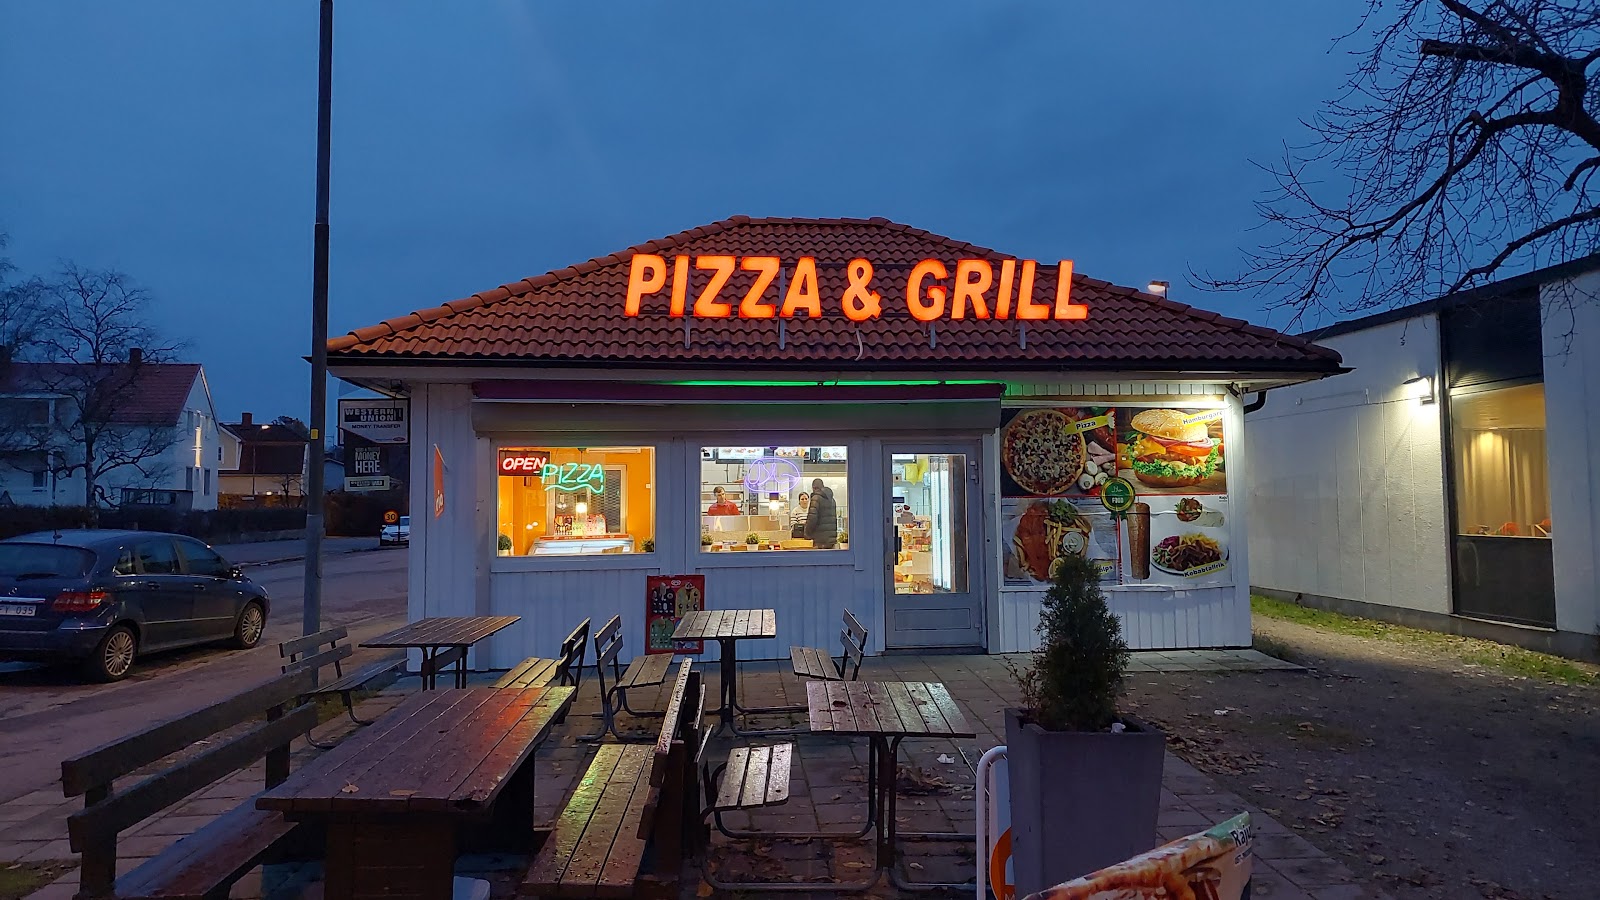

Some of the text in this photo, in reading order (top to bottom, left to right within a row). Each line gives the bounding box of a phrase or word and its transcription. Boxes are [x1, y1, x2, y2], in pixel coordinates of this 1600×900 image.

[624, 253, 1089, 322] PIZZA & GRILL
[344, 408, 394, 416] WESTERN
[1075, 420, 1096, 430] Pizza
[355, 451, 381, 461] MONEY
[355, 460, 381, 474] HERE
[502, 457, 548, 471] OPEN
[541, 462, 604, 485] PIZZA
[386, 513, 396, 521] 30
[16, 605, 34, 615] 035
